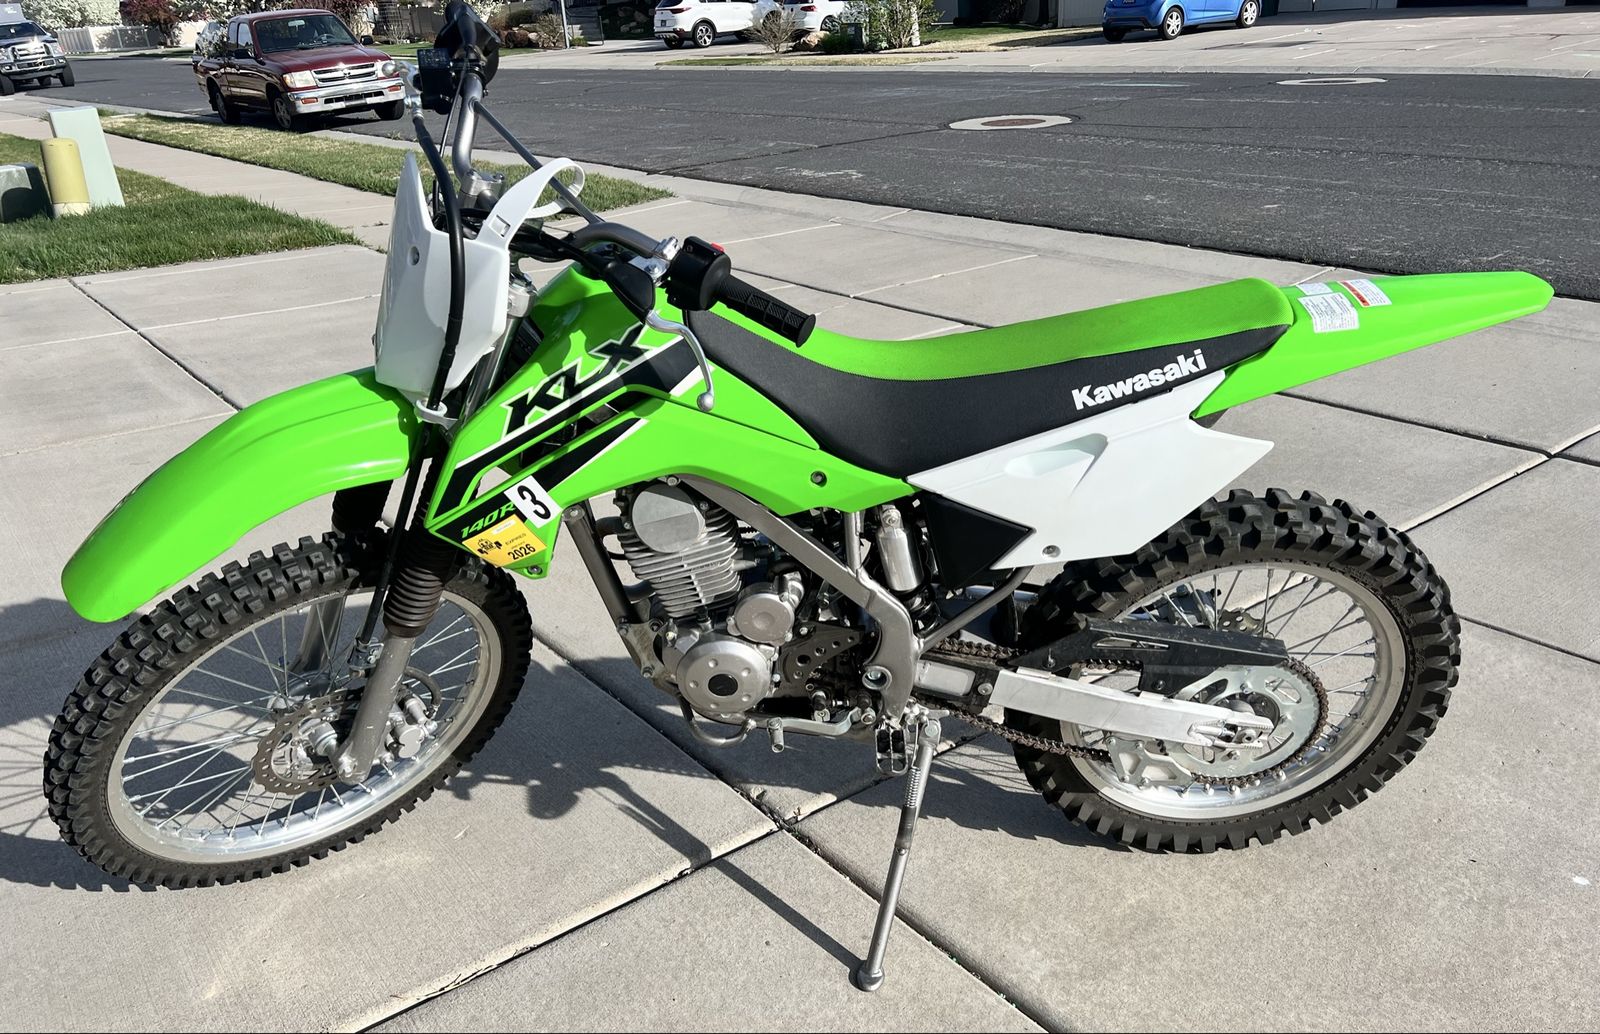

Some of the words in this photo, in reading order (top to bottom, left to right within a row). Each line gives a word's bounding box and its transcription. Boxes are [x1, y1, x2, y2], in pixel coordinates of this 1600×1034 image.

[501, 322, 650, 439] KLX
[1071, 348, 1207, 411] Kawasaki
[461, 501, 516, 539] 140R
[517, 484, 552, 520] 3
[508, 542, 536, 561] 2026
